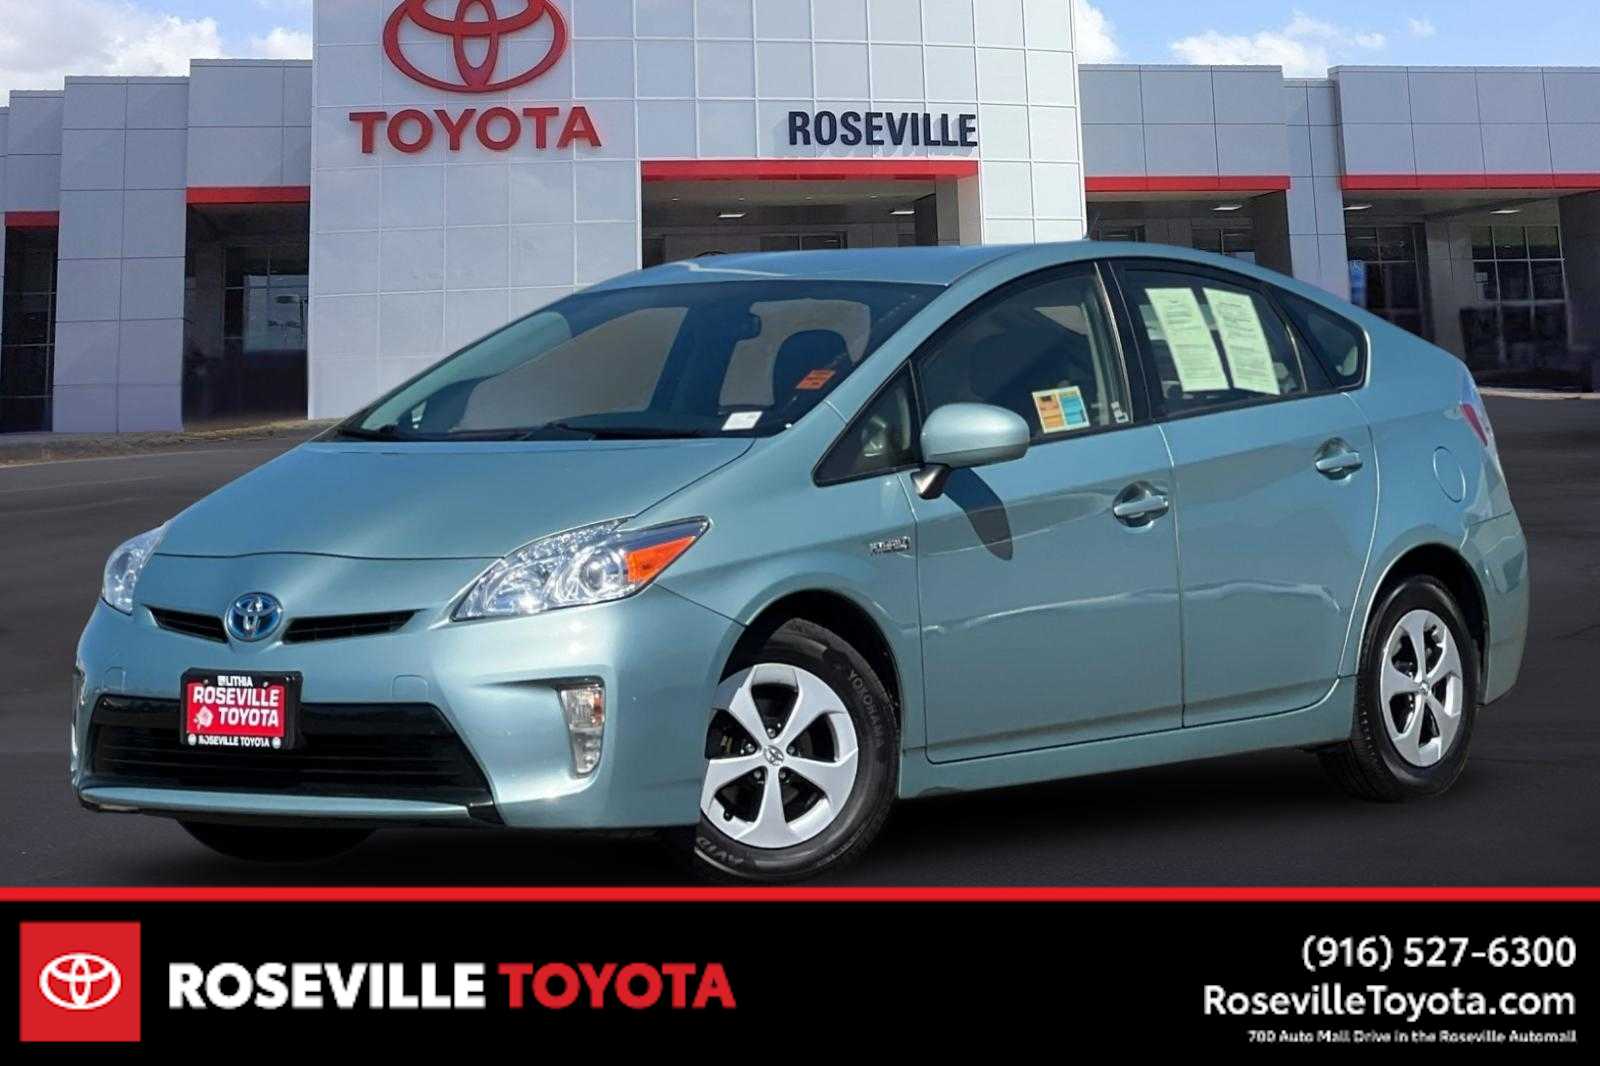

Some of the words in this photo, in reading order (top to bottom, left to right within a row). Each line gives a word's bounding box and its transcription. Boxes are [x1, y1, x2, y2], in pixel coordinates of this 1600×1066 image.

[348, 106, 602, 153] TOYOTA
[788, 110, 978, 147] ROSEVILLE
[225, 675, 253, 687] LITHIA
[192, 686, 280, 707] ROSEVILLE
[218, 706, 279, 727] TOYOTA
[198, 735, 239, 747] ROSEVILLE
[240, 736, 270, 748] TOYOTA
